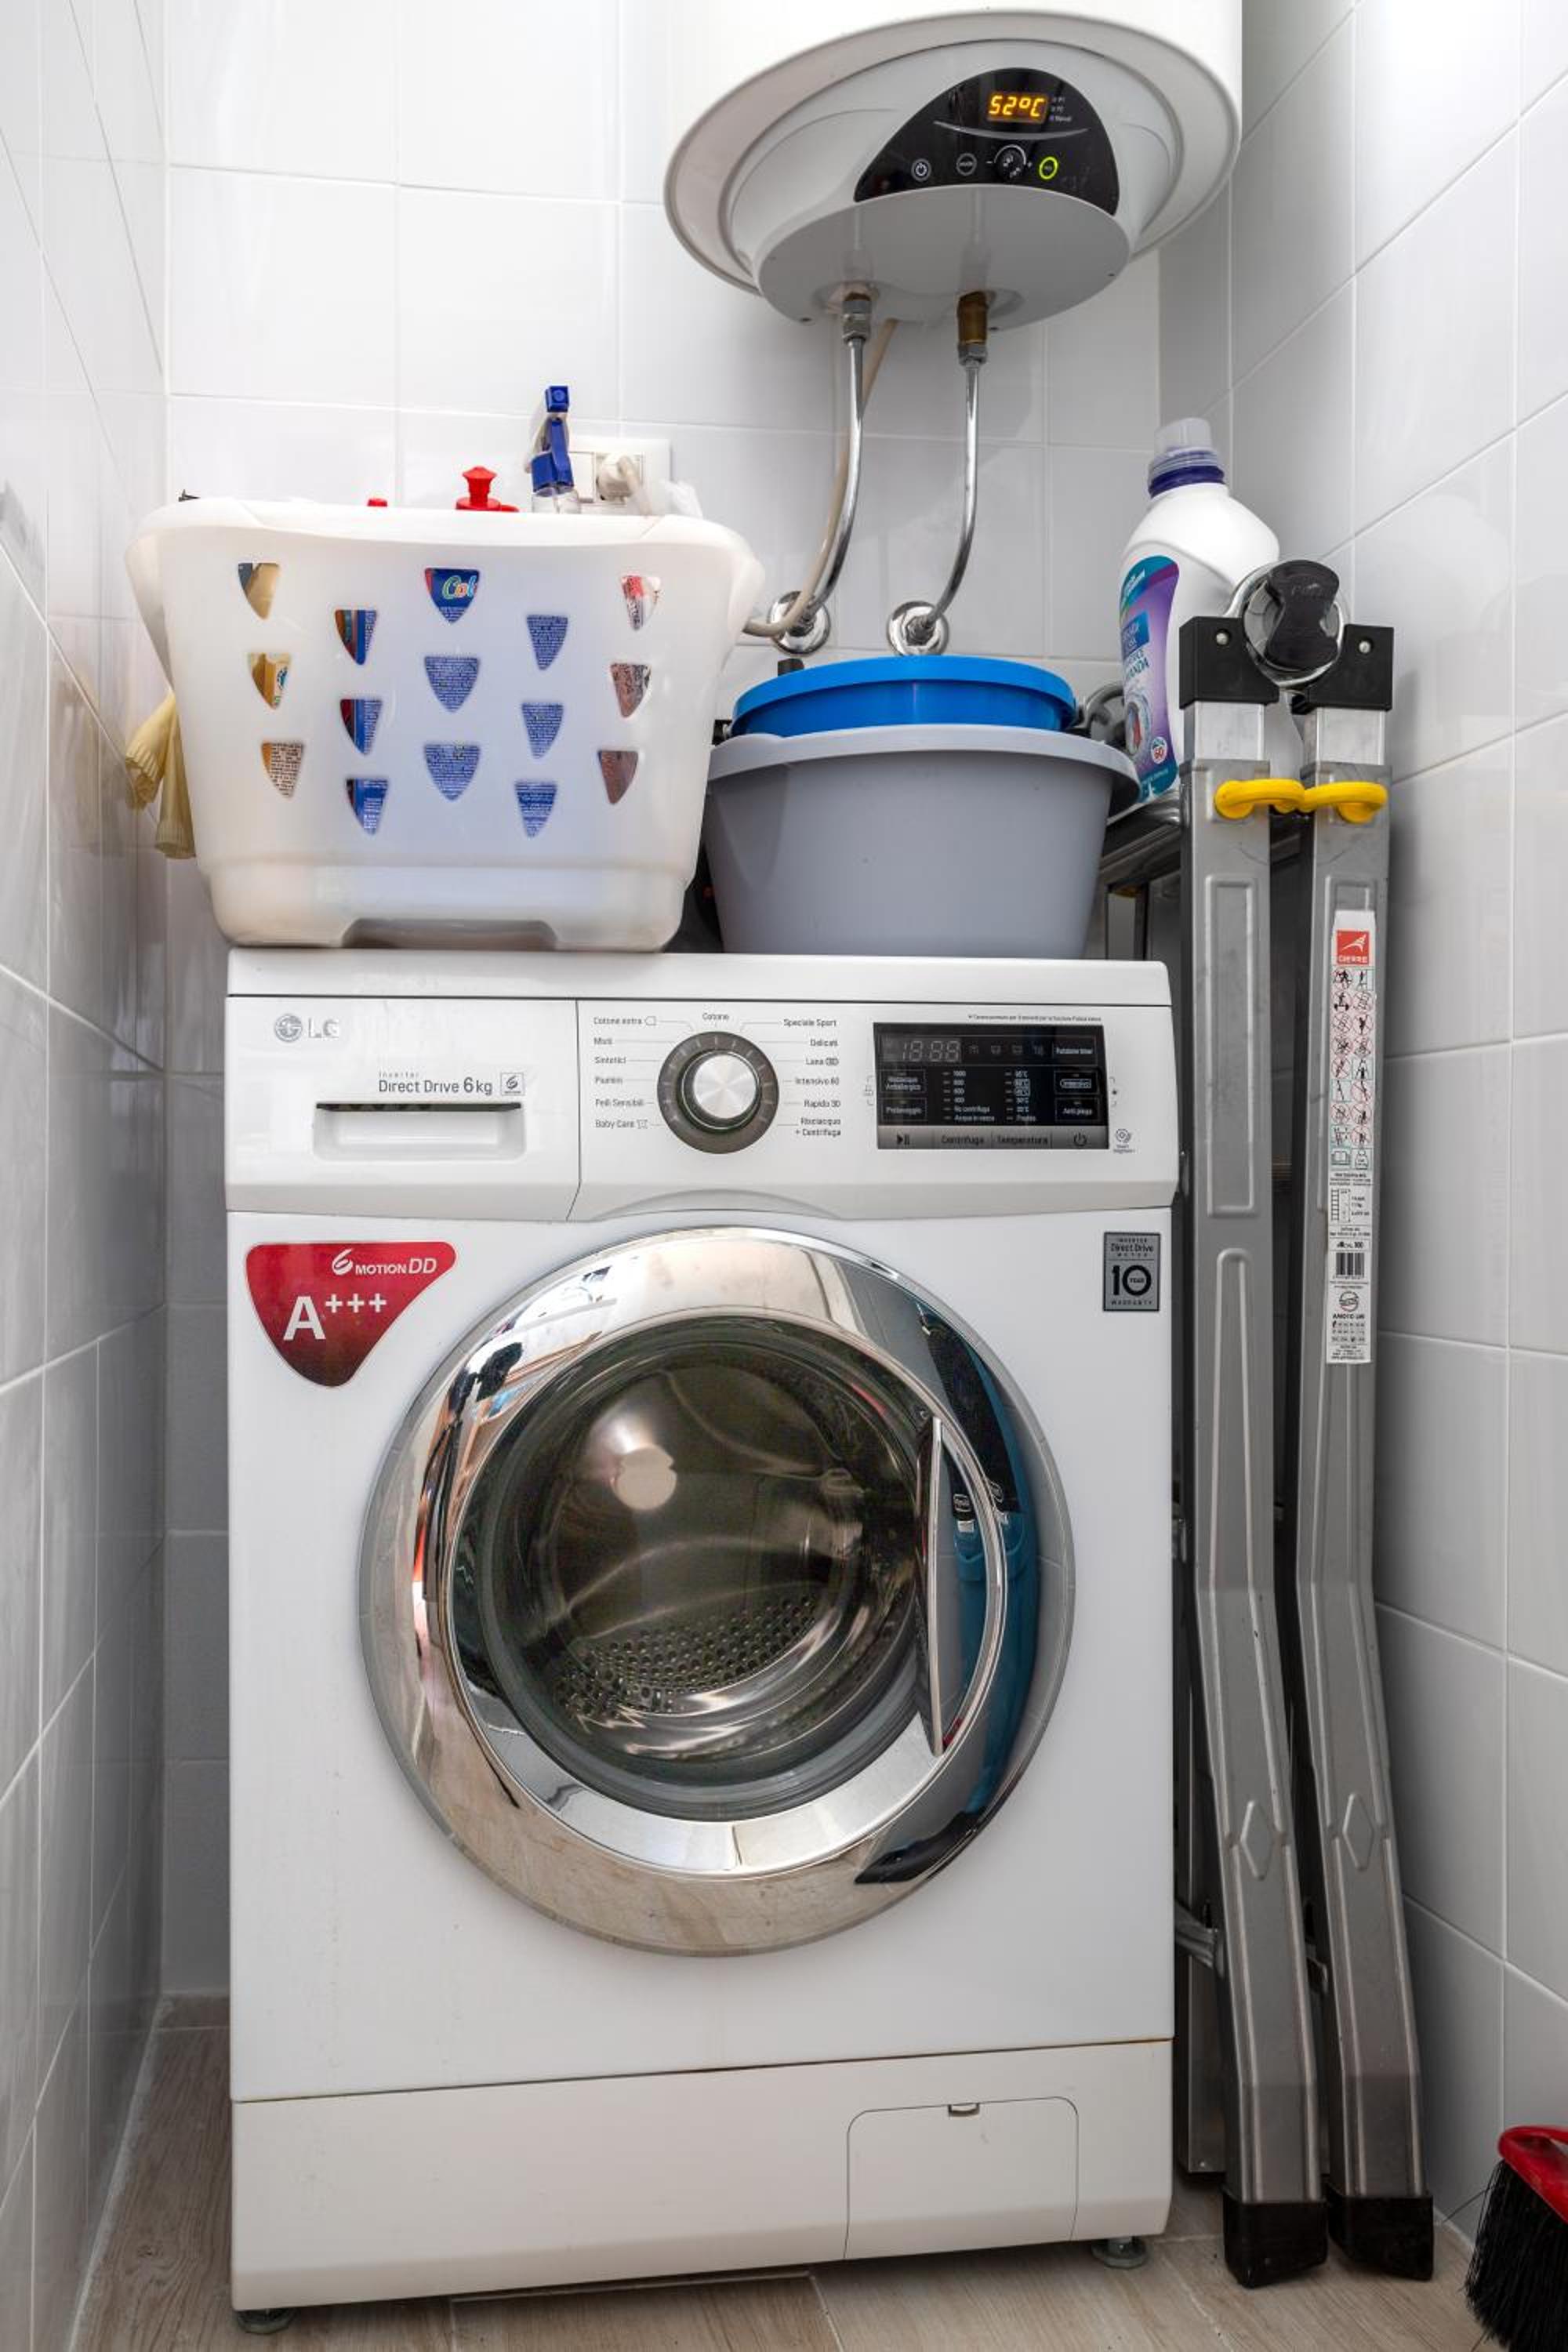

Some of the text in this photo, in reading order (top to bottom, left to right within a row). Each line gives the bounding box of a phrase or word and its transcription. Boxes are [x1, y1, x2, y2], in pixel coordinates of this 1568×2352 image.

[308, 1018, 339, 1038] LG
[816, 1019, 837, 1028] Sport
[379, 1080, 421, 1093] Direct
[424, 1080, 460, 1093] Drive
[804, 1099, 829, 1109] Rapido
[595, 1119, 615, 1129] Baby
[283, 1293, 387, 1341] A+++
